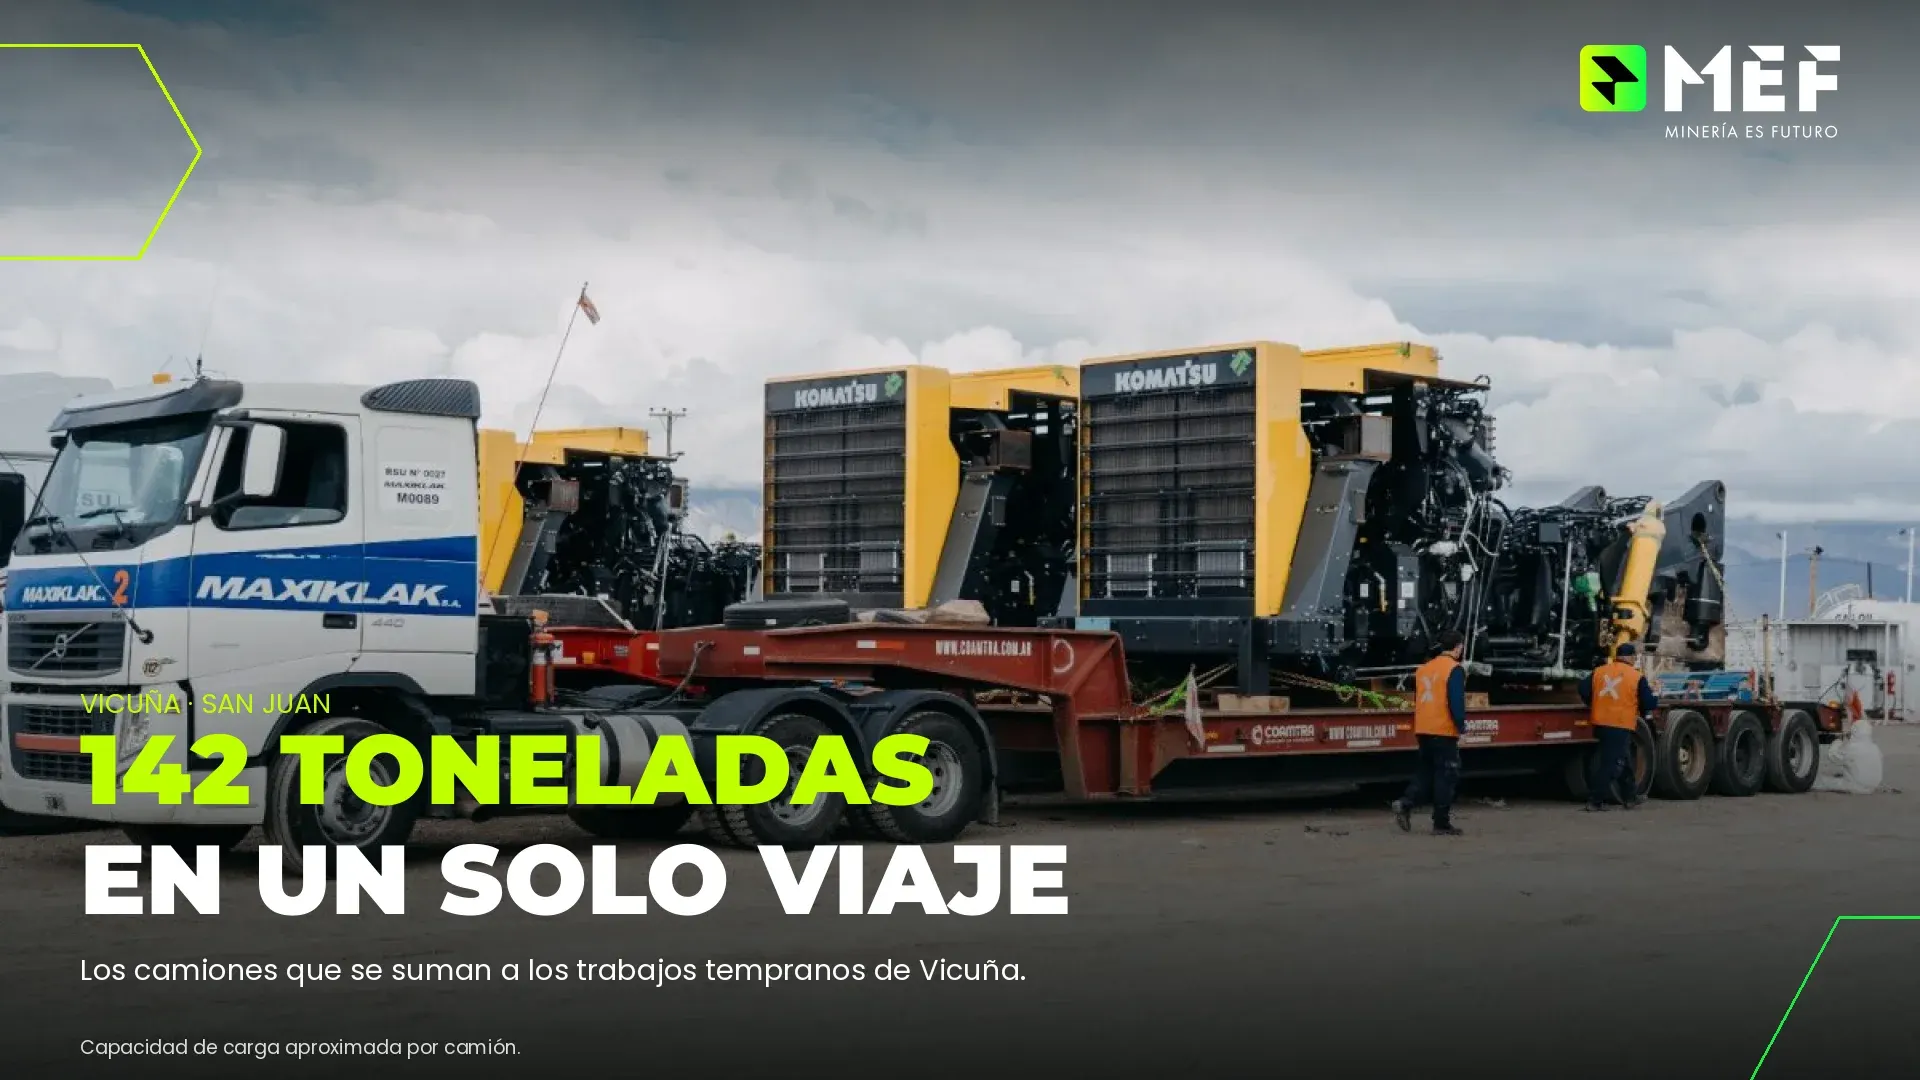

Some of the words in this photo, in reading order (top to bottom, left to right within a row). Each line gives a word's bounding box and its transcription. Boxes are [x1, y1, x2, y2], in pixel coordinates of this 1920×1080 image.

[1115, 360, 1217, 393] KOMATSU
[794, 380, 878, 408] KOMATSU
[397, 492, 440, 505] M0089
[22, 584, 102, 603] MAXIKLAK
[111, 569, 130, 606] 2
[196, 574, 448, 608] MAXIKLAK
